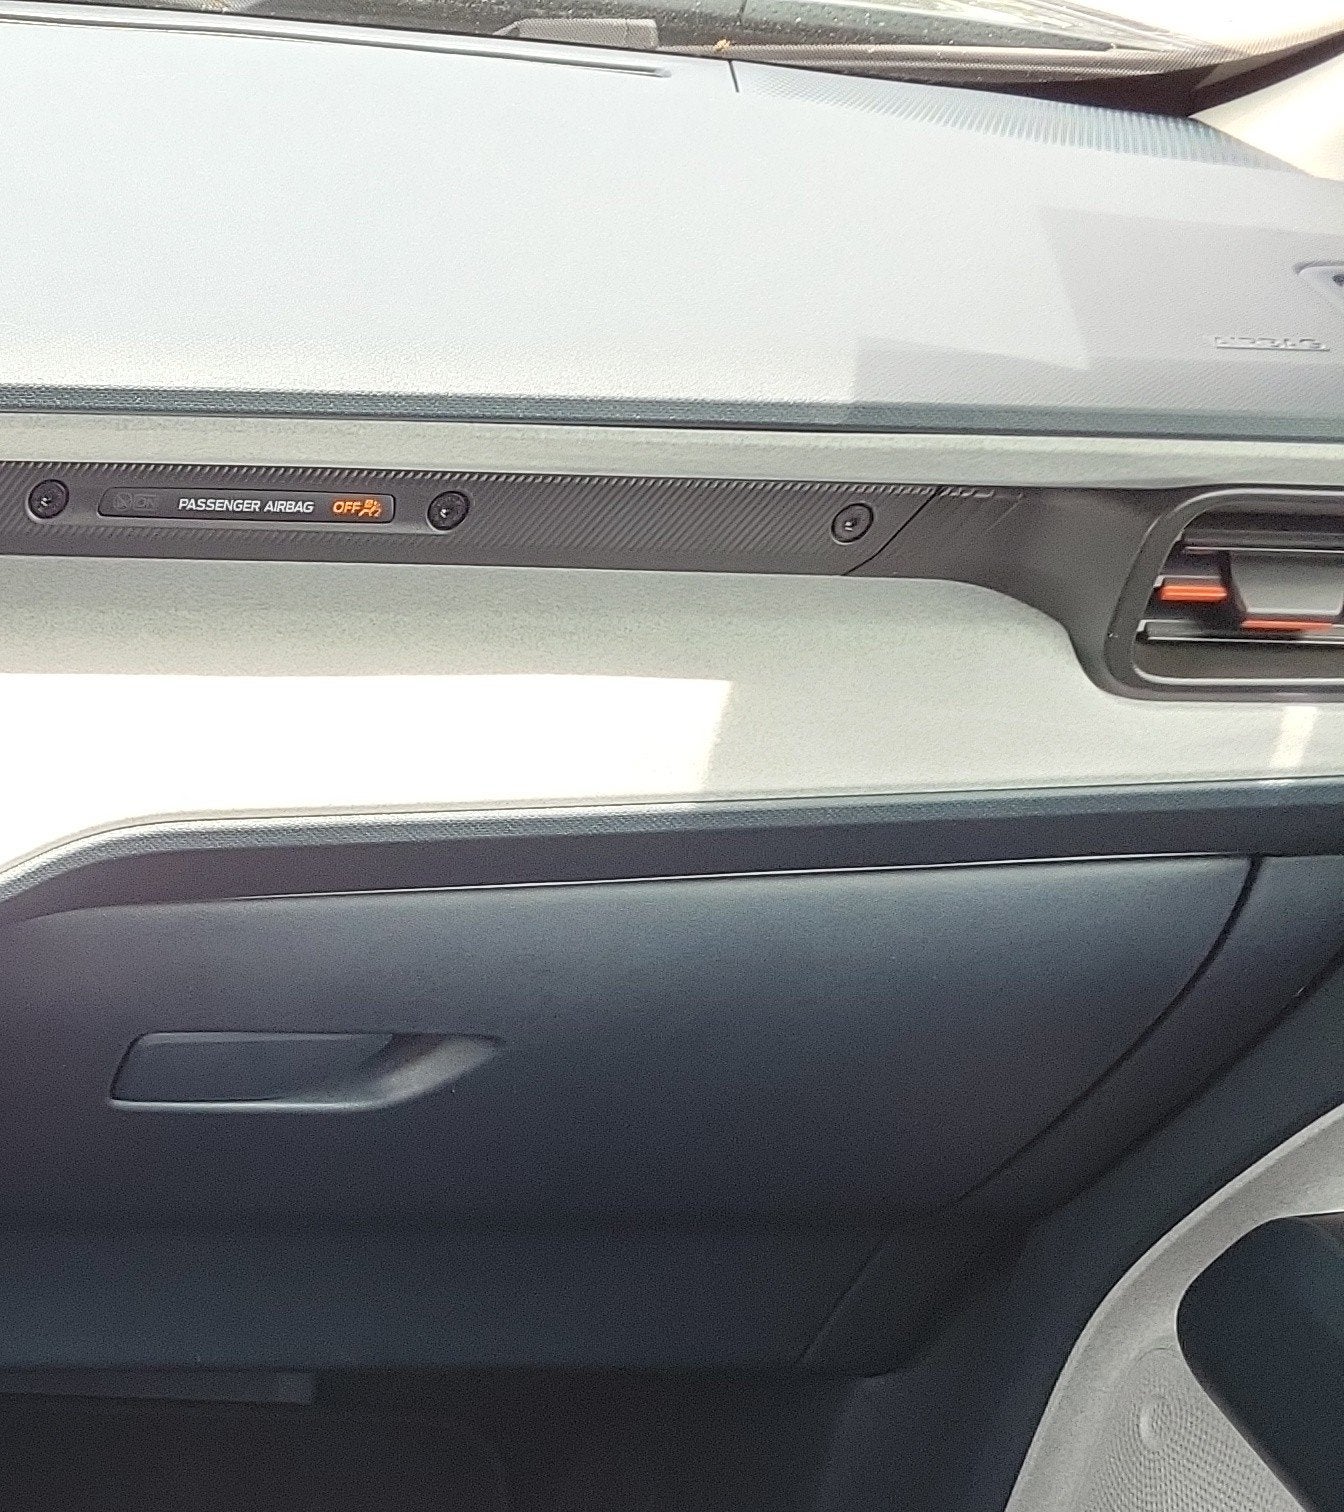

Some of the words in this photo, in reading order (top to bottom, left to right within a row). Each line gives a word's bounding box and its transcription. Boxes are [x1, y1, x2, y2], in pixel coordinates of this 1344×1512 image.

[178, 498, 261, 512] PASSENGER
[264, 500, 314, 513] AIRBAG
[332, 501, 362, 513] OFF
